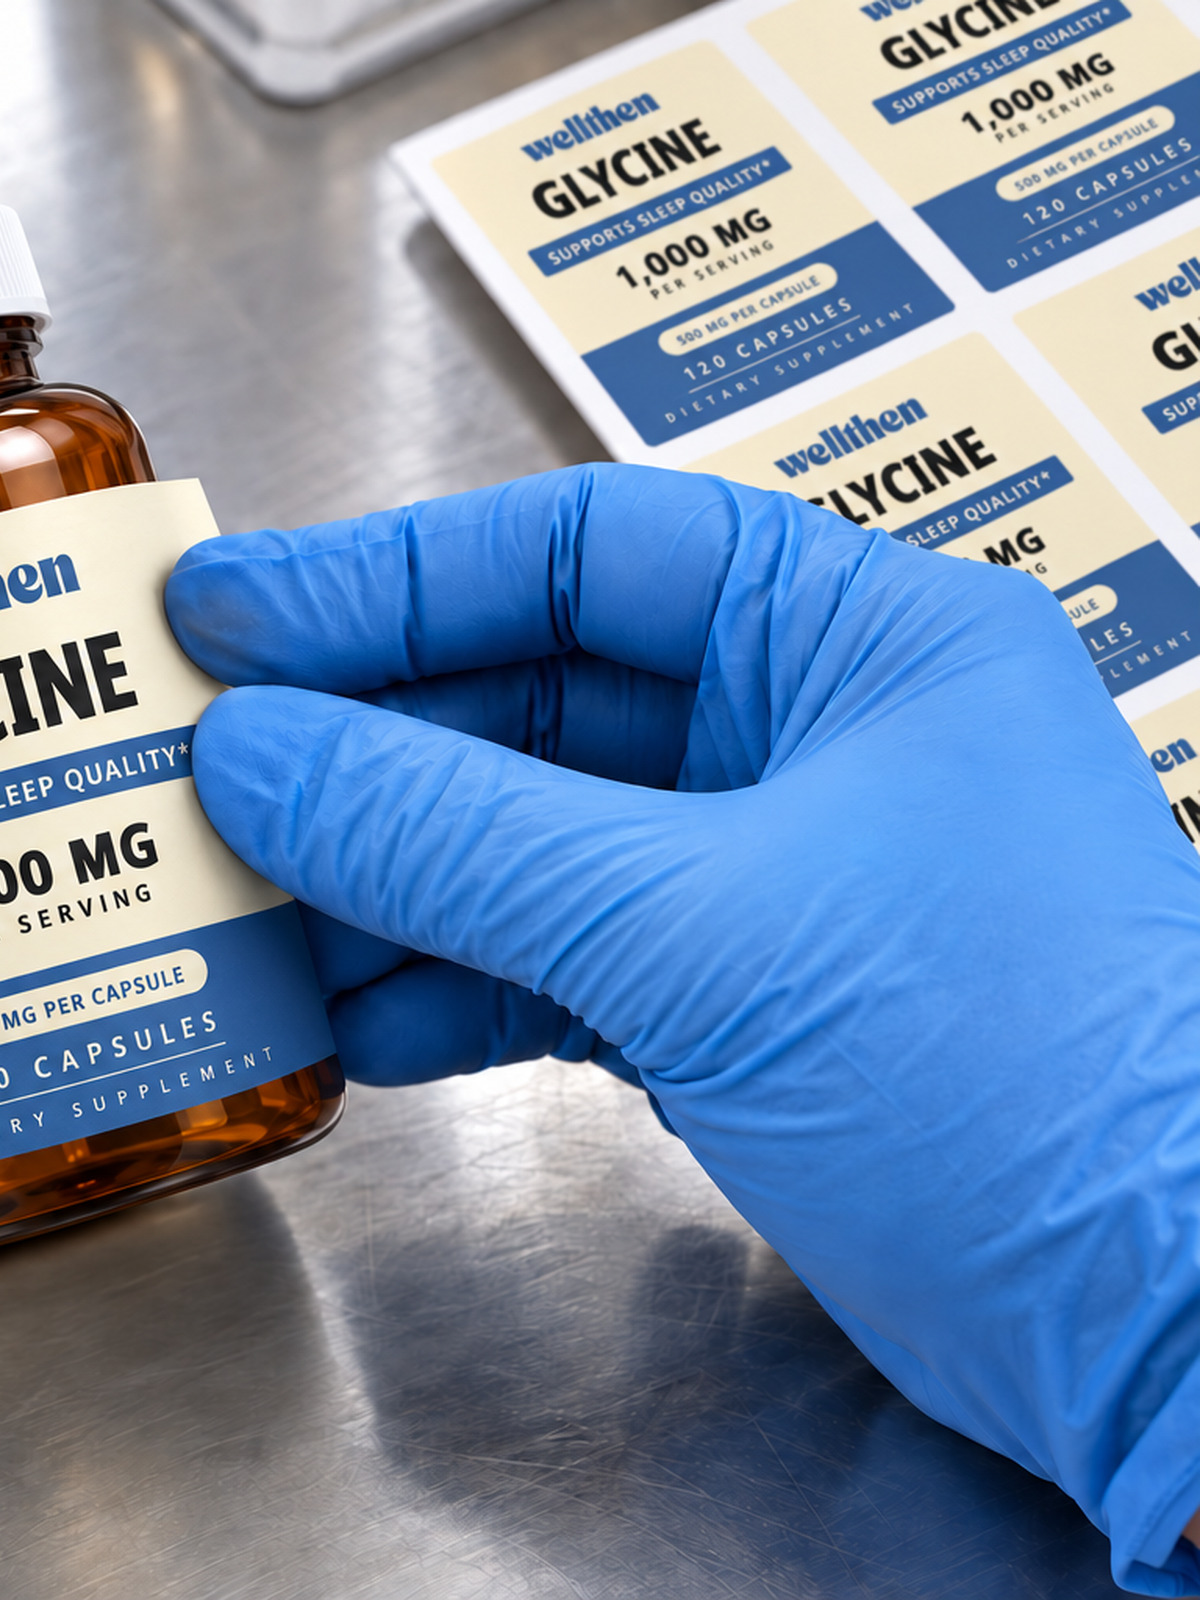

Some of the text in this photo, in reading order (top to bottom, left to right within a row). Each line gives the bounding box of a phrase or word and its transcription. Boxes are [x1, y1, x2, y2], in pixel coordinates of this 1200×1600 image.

[892, 68, 982, 115] SUPPORTS
[981, 44, 1030, 75] SLEEP
[961, 53, 1116, 134] 1,000 MG
[994, 83, 1115, 143] PER SERVING
[520, 93, 660, 162] wellthen
[1069, 148, 1097, 166] PER
[531, 118, 722, 219] GLYCINE
[1022, 137, 1192, 225] 120 CAPSULES
[547, 219, 636, 266] SUPPORTS
[637, 197, 686, 227] SLEEP
[615, 208, 772, 289] 1,000 MG
[1006, 169, 1200, 269] DIETARY SUPPLE
[650, 239, 775, 300] PER SERVING
[705, 316, 729, 334] MG
[730, 304, 758, 323] PER
[760, 274, 821, 310] CAPSULE
[665, 303, 915, 424] DIETARY SUPPLEMENT
[683, 297, 852, 381] 120 CAPSULES
[773, 397, 929, 479] wellthen
[806, 426, 998, 526] LYCINE
[905, 515, 960, 548] SLEEP
[983, 527, 1046, 567] MG
[1109, 630, 1191, 679] LEMENT
[70, 822, 159, 886] MG
[18, 882, 152, 934] SERVING
[1, 1007, 37, 1032] MG
[43, 994, 86, 1023] PER
[91, 965, 185, 1008] CAPSULE
[33, 1010, 218, 1077] CAPSULES
[73, 1045, 275, 1118] SUPPLEMENT
